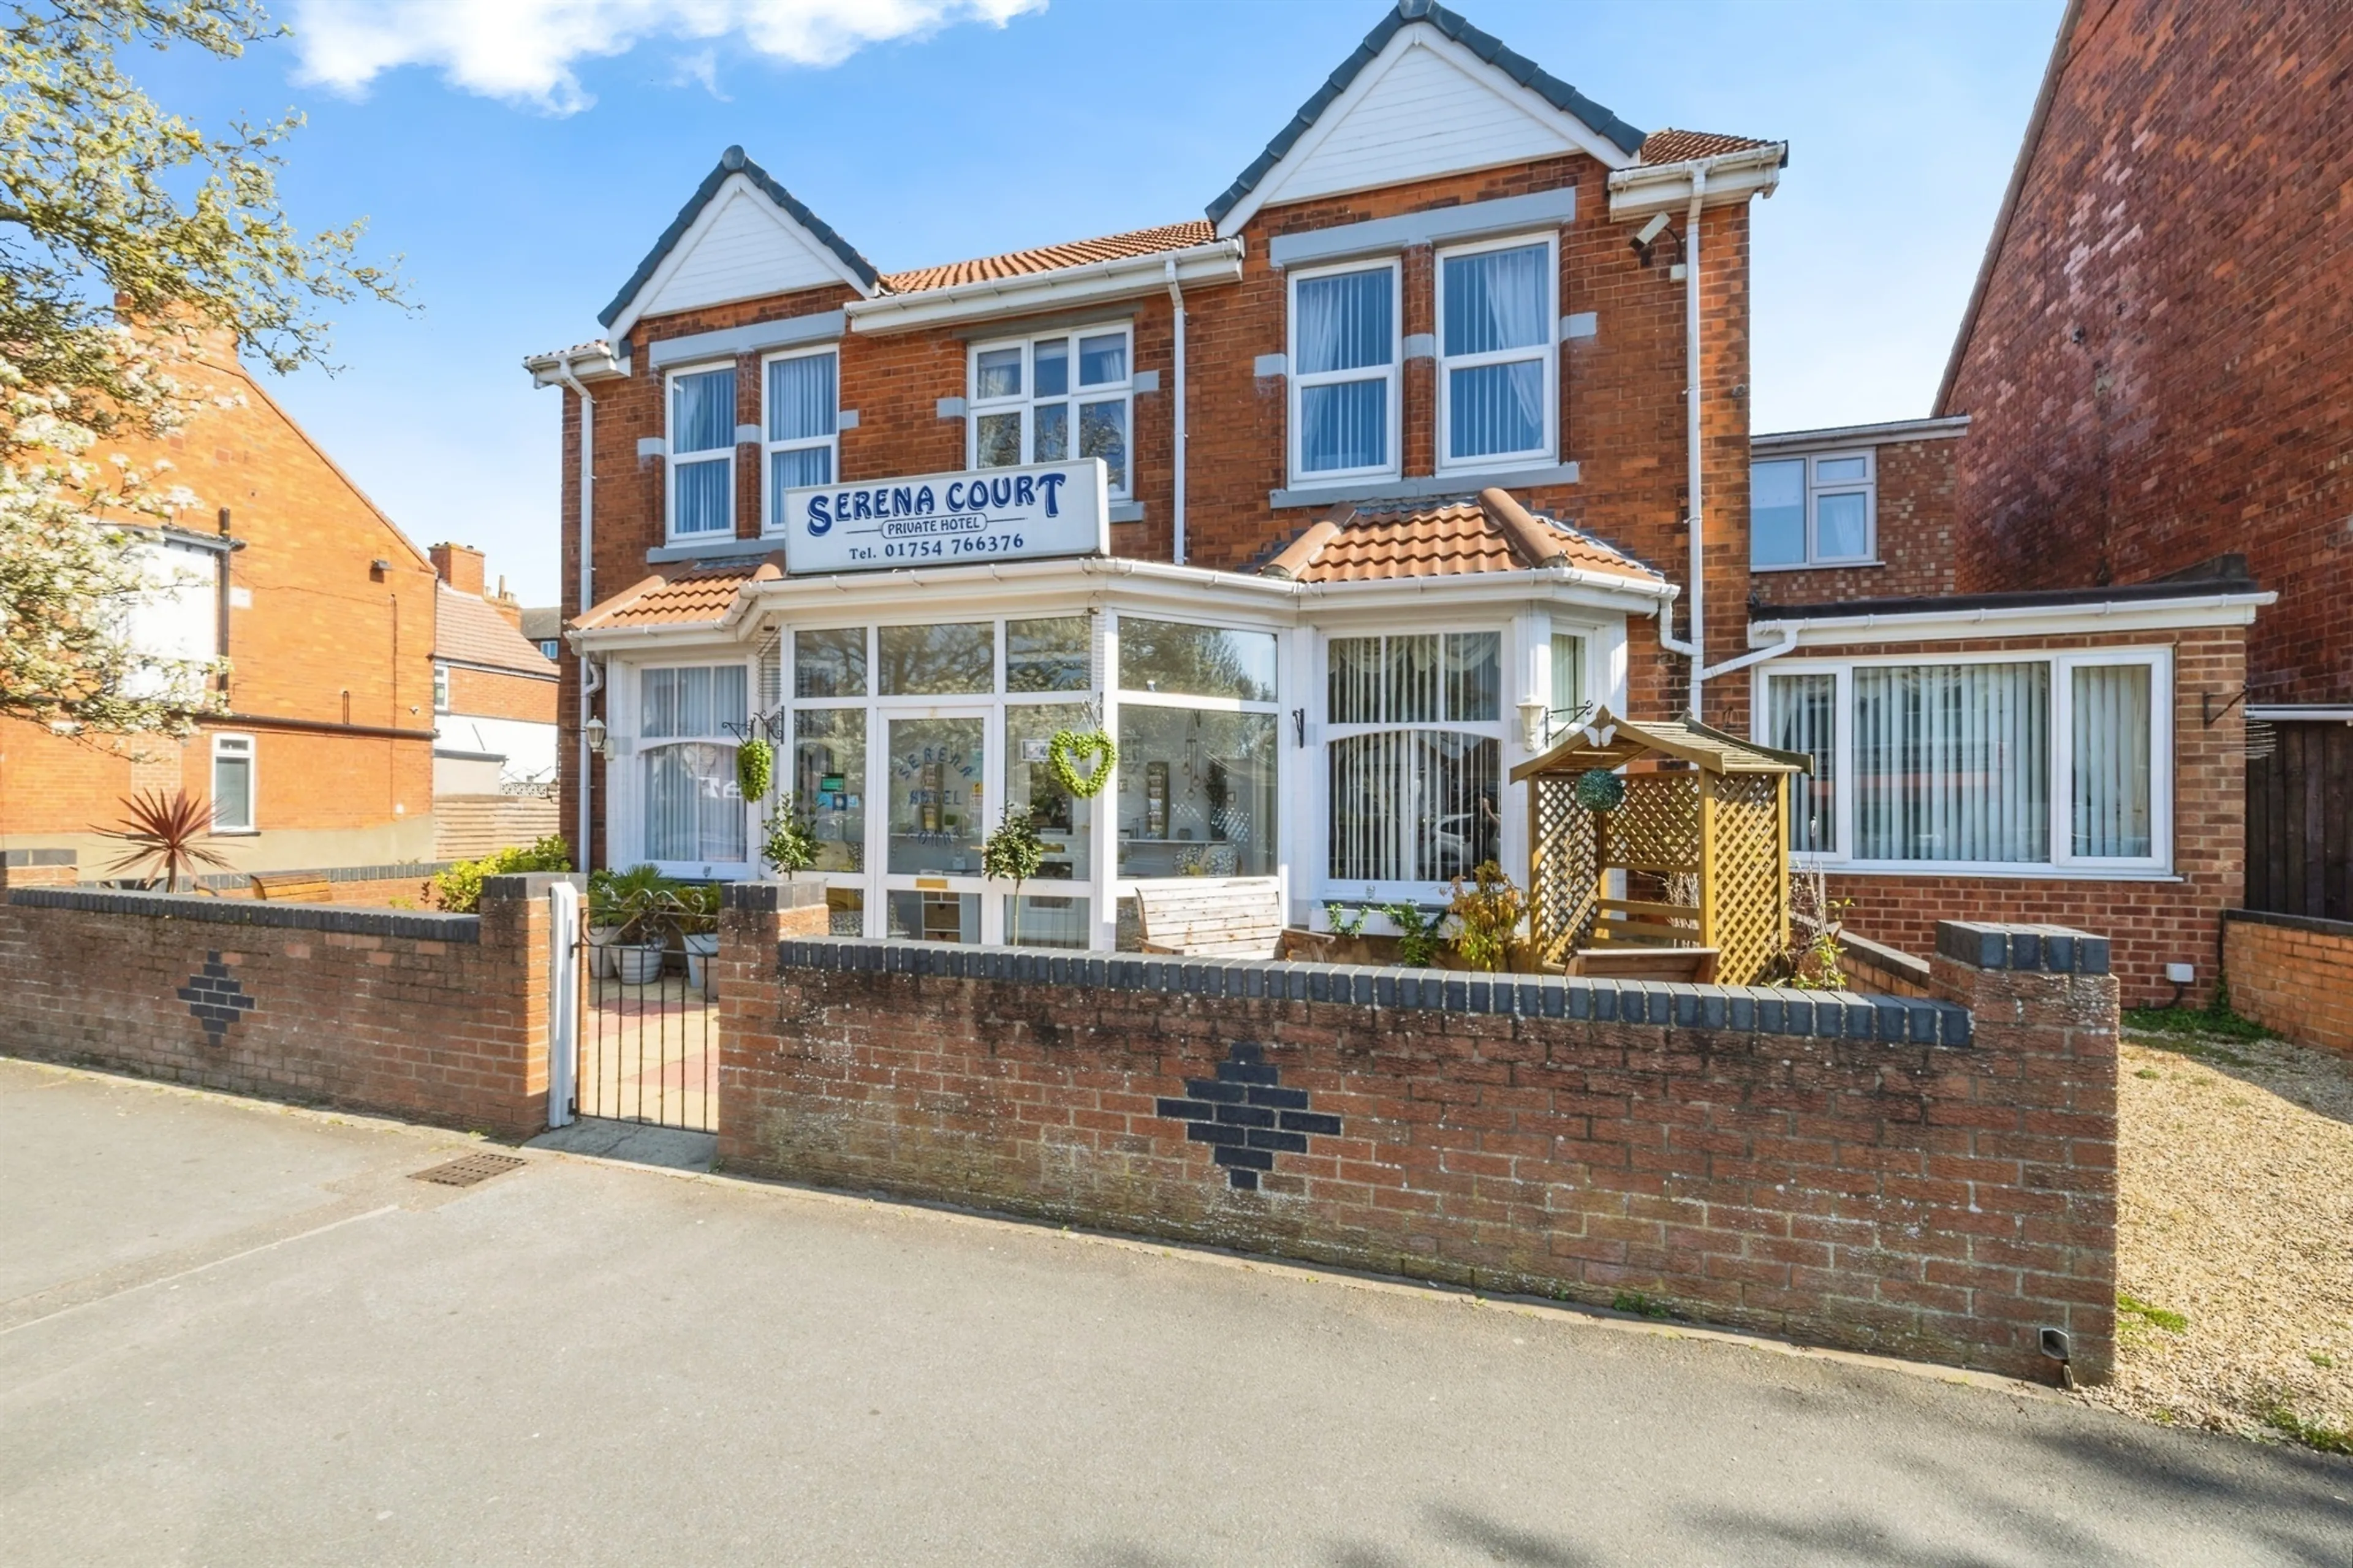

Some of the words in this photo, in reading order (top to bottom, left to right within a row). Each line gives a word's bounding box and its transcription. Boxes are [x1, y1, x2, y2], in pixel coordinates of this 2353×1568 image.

[808, 485, 935, 537] SERENA
[945, 473, 1067, 518] COURT
[888, 521, 938, 536] PRIVATE
[941, 517, 980, 531] HOTEL
[849, 547, 877, 560] Tel.
[885, 540, 942, 558] 01754
[951, 533, 1024, 555] 766376
[898, 747, 973, 781] SERENA
[909, 790, 963, 806] HOTEL
